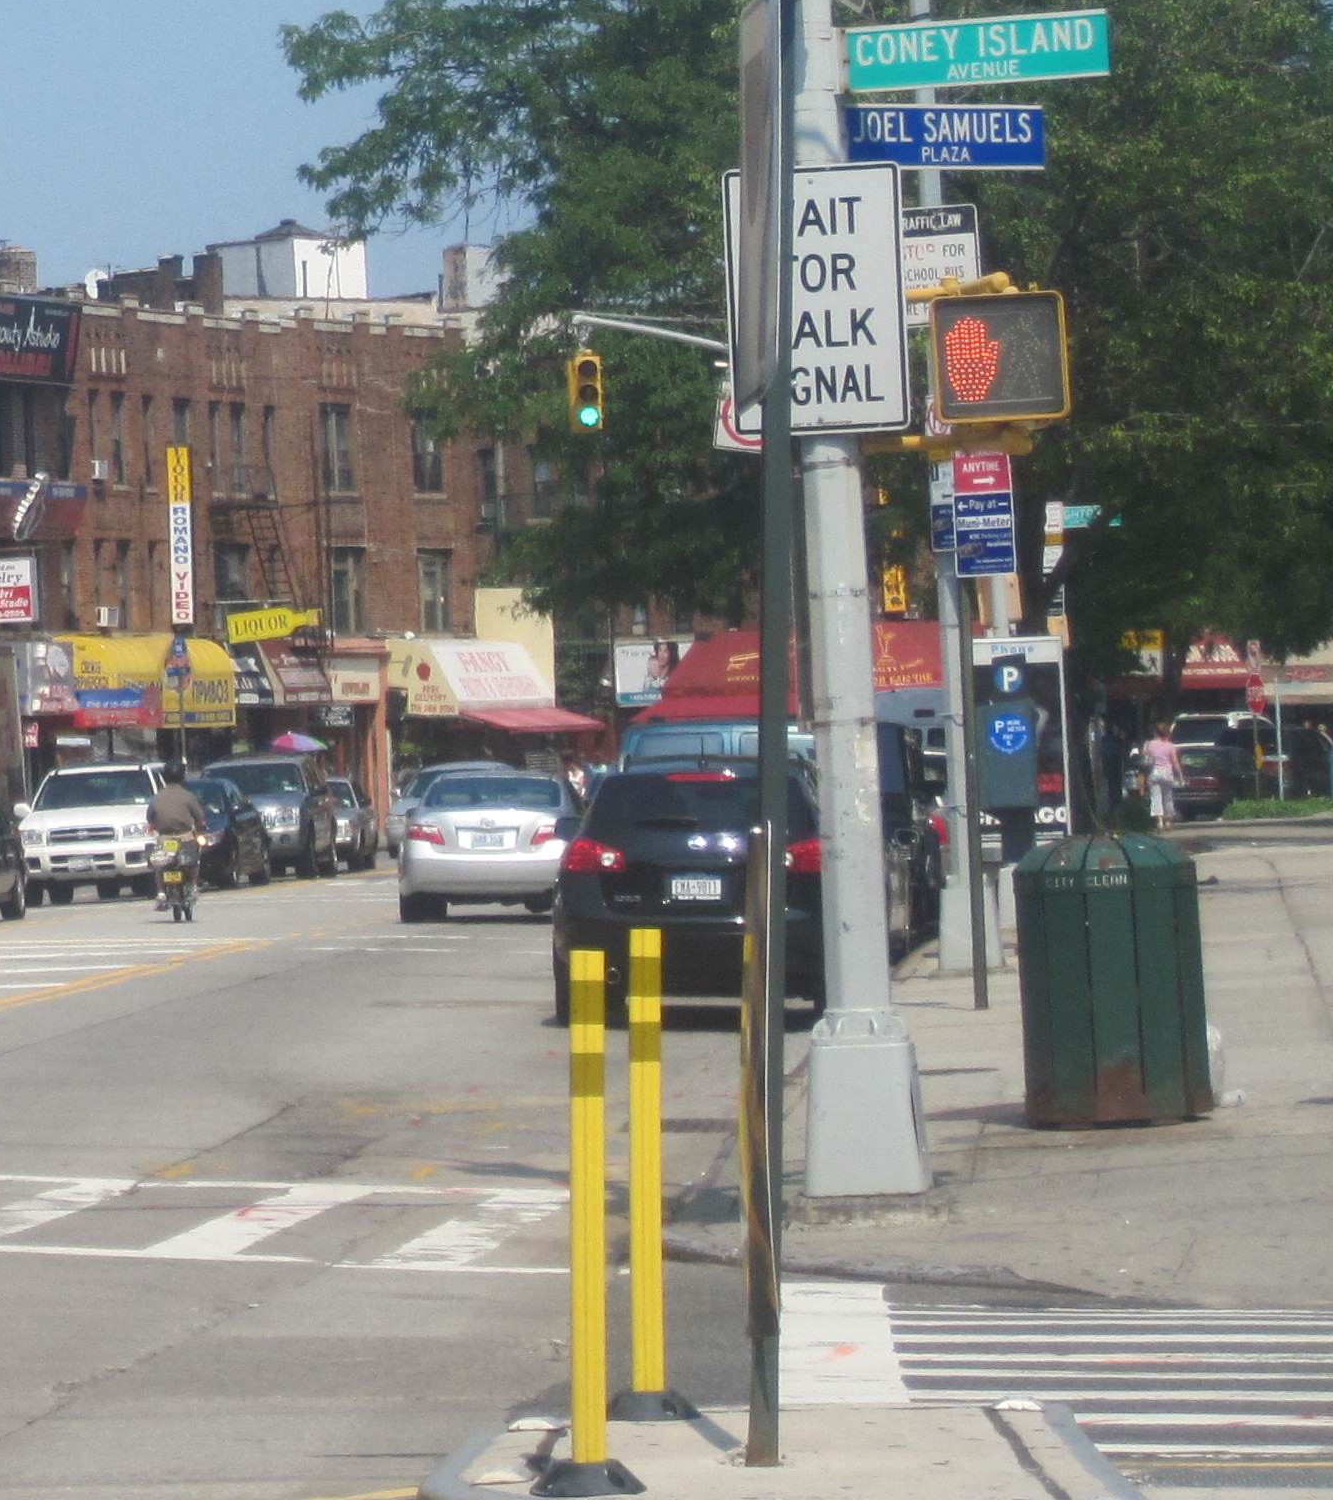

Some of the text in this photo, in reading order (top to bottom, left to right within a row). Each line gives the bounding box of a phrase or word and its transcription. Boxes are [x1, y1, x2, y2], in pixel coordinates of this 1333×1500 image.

[856, 18, 1094, 66] CONEY ISLAND
[946, 60, 1021, 80] AVENUE
[853, 110, 1032, 144] JOEL SAMUELS
[921, 146, 971, 162] PLAZA
[797, 196, 862, 237] AIT
[903, 214, 937, 231] RAFFIC
[942, 243, 966, 257] FOR
[792, 307, 878, 350] ALK
[791, 363, 885, 406] GNAL
[962, 461, 1000, 473] ANYTIME
[969, 499, 997, 512] Pay at
[173, 506, 189, 565] ROMANO
[0, 598, 29, 609] Studio
[174, 571, 190, 620] VIDEO
[234, 613, 288, 636] LIQUOR
[990, 644, 1034, 654] Phone
[457, 651, 511, 673] FANCY
[1002, 665, 1019, 692] P
